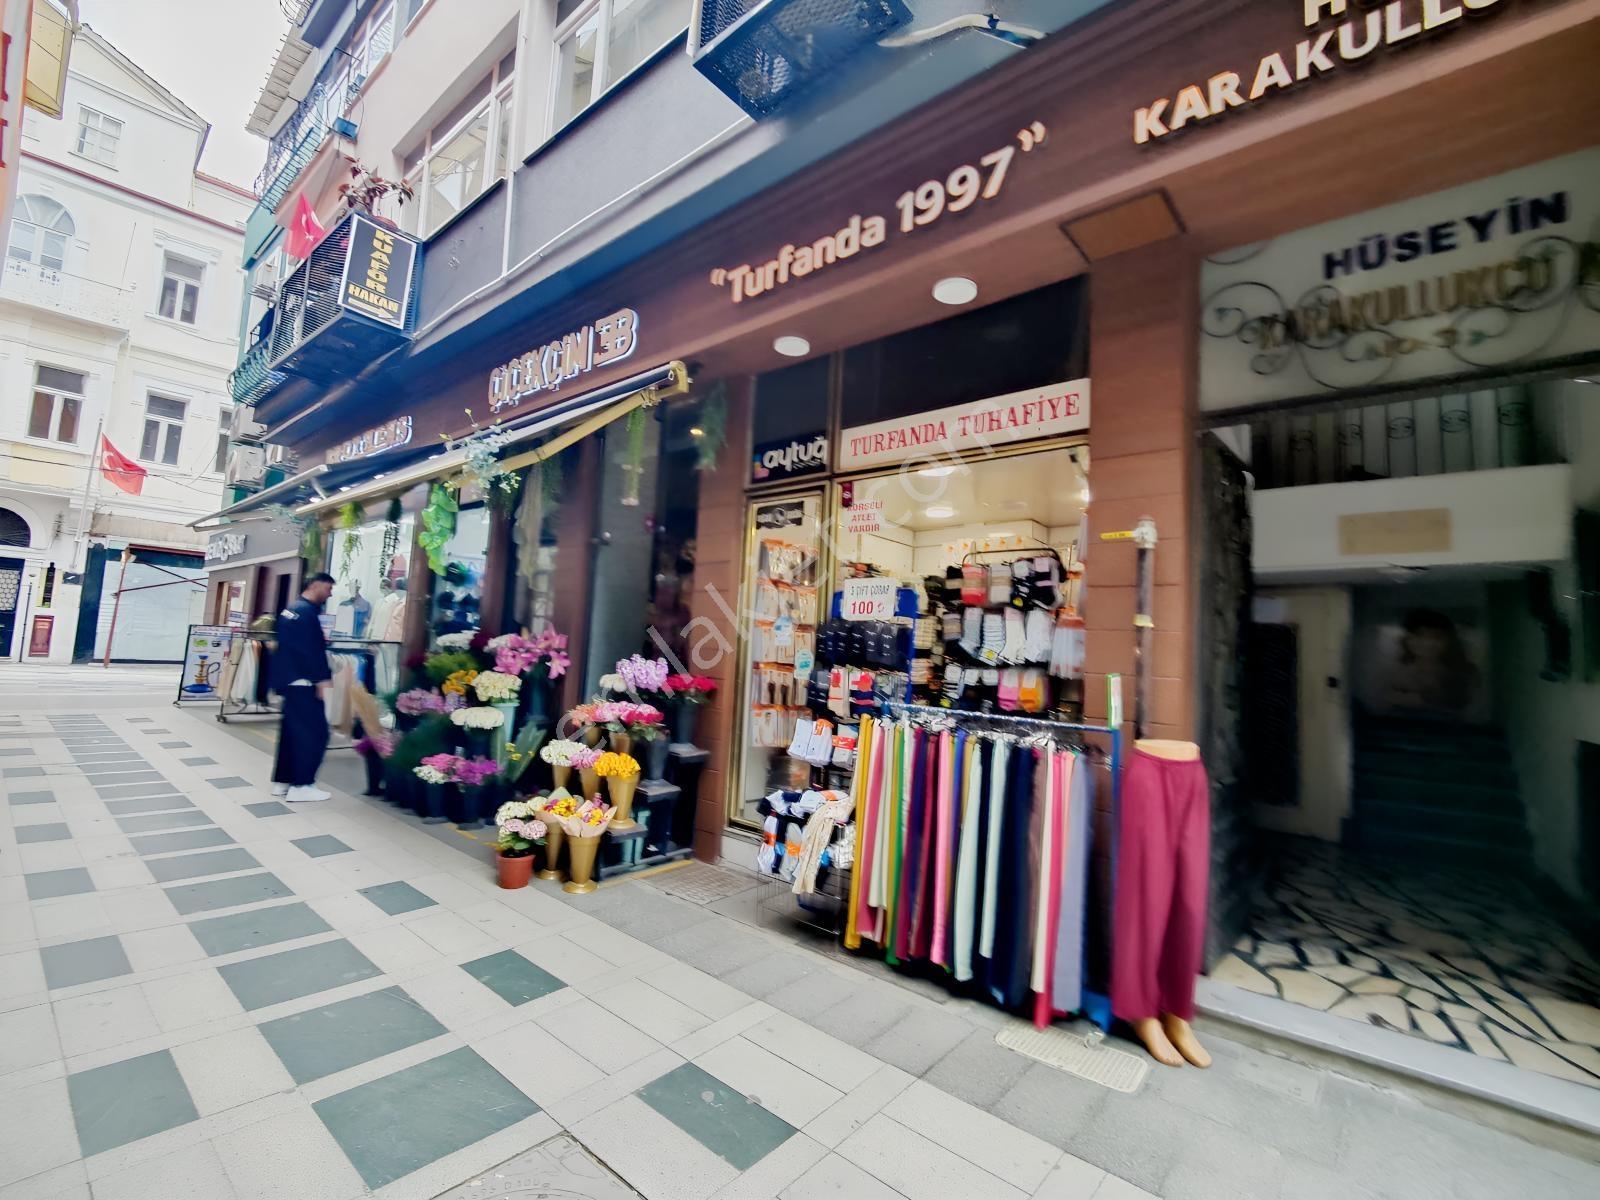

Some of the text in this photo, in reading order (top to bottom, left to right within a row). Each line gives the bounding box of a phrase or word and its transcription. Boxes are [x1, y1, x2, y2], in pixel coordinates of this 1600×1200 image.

[1133, 0, 1500, 144] KARAKULL
[1323, 192, 1567, 280] HÜSEYİN
[348, 283, 399, 312] HAKAN
[850, 394, 1080, 456] TURFANDA TUHAFİYE
[851, 601, 874, 615] 100
